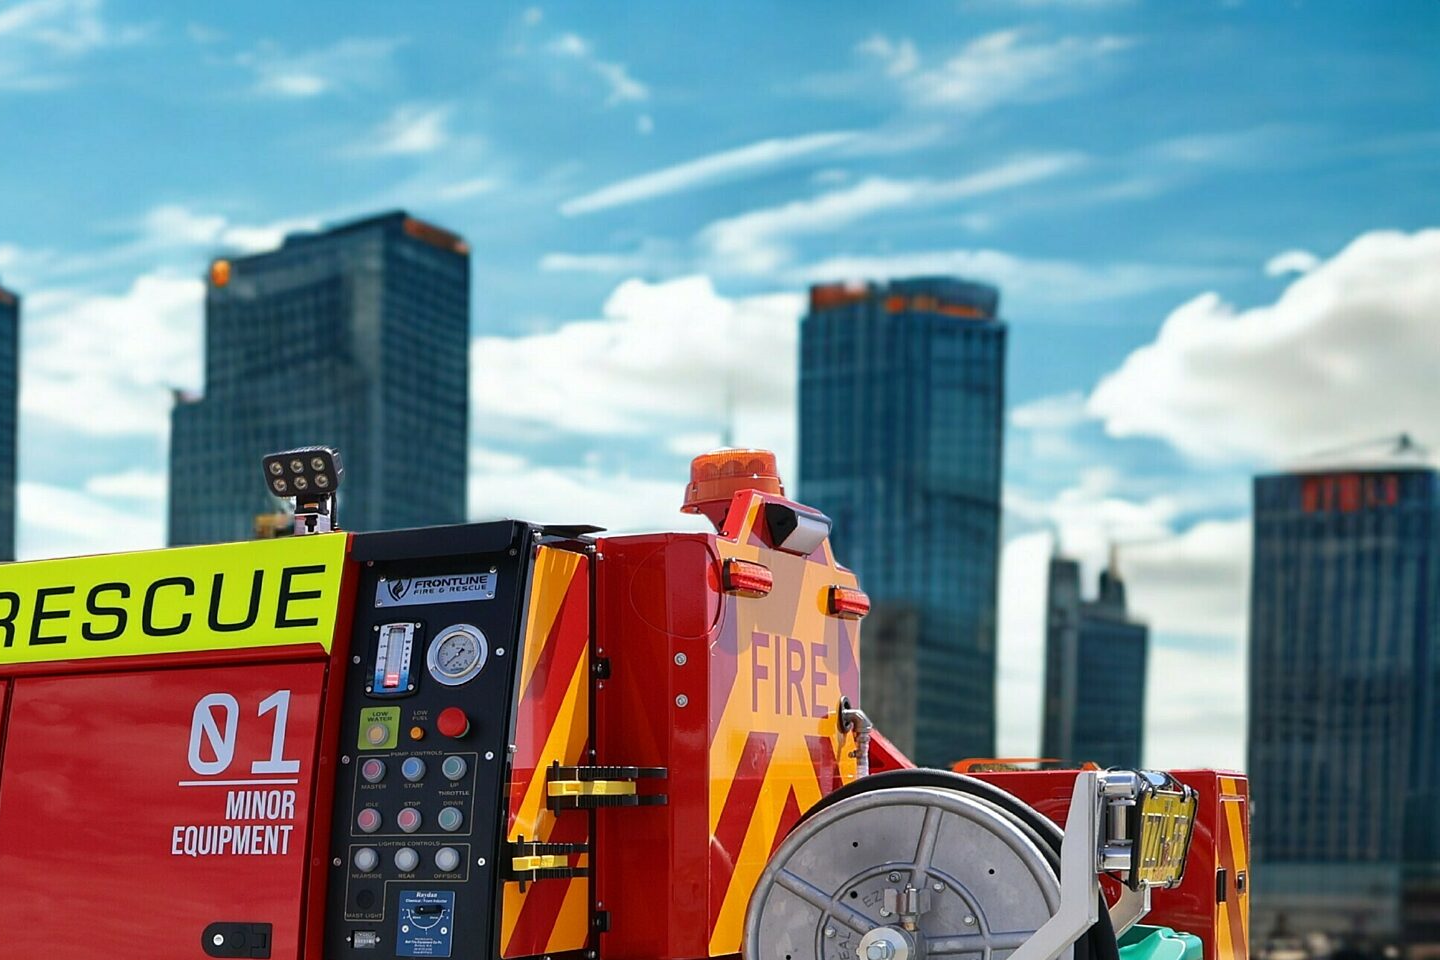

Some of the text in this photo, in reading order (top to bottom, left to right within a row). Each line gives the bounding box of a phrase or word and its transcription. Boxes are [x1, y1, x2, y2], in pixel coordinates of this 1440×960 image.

[415, 575, 488, 588] FRONTLINE
[751, 631, 829, 718] FIRE
[188, 690, 300, 775] 01
[225, 790, 296, 820] MINOR
[171, 825, 293, 858] EQUIPMENT
